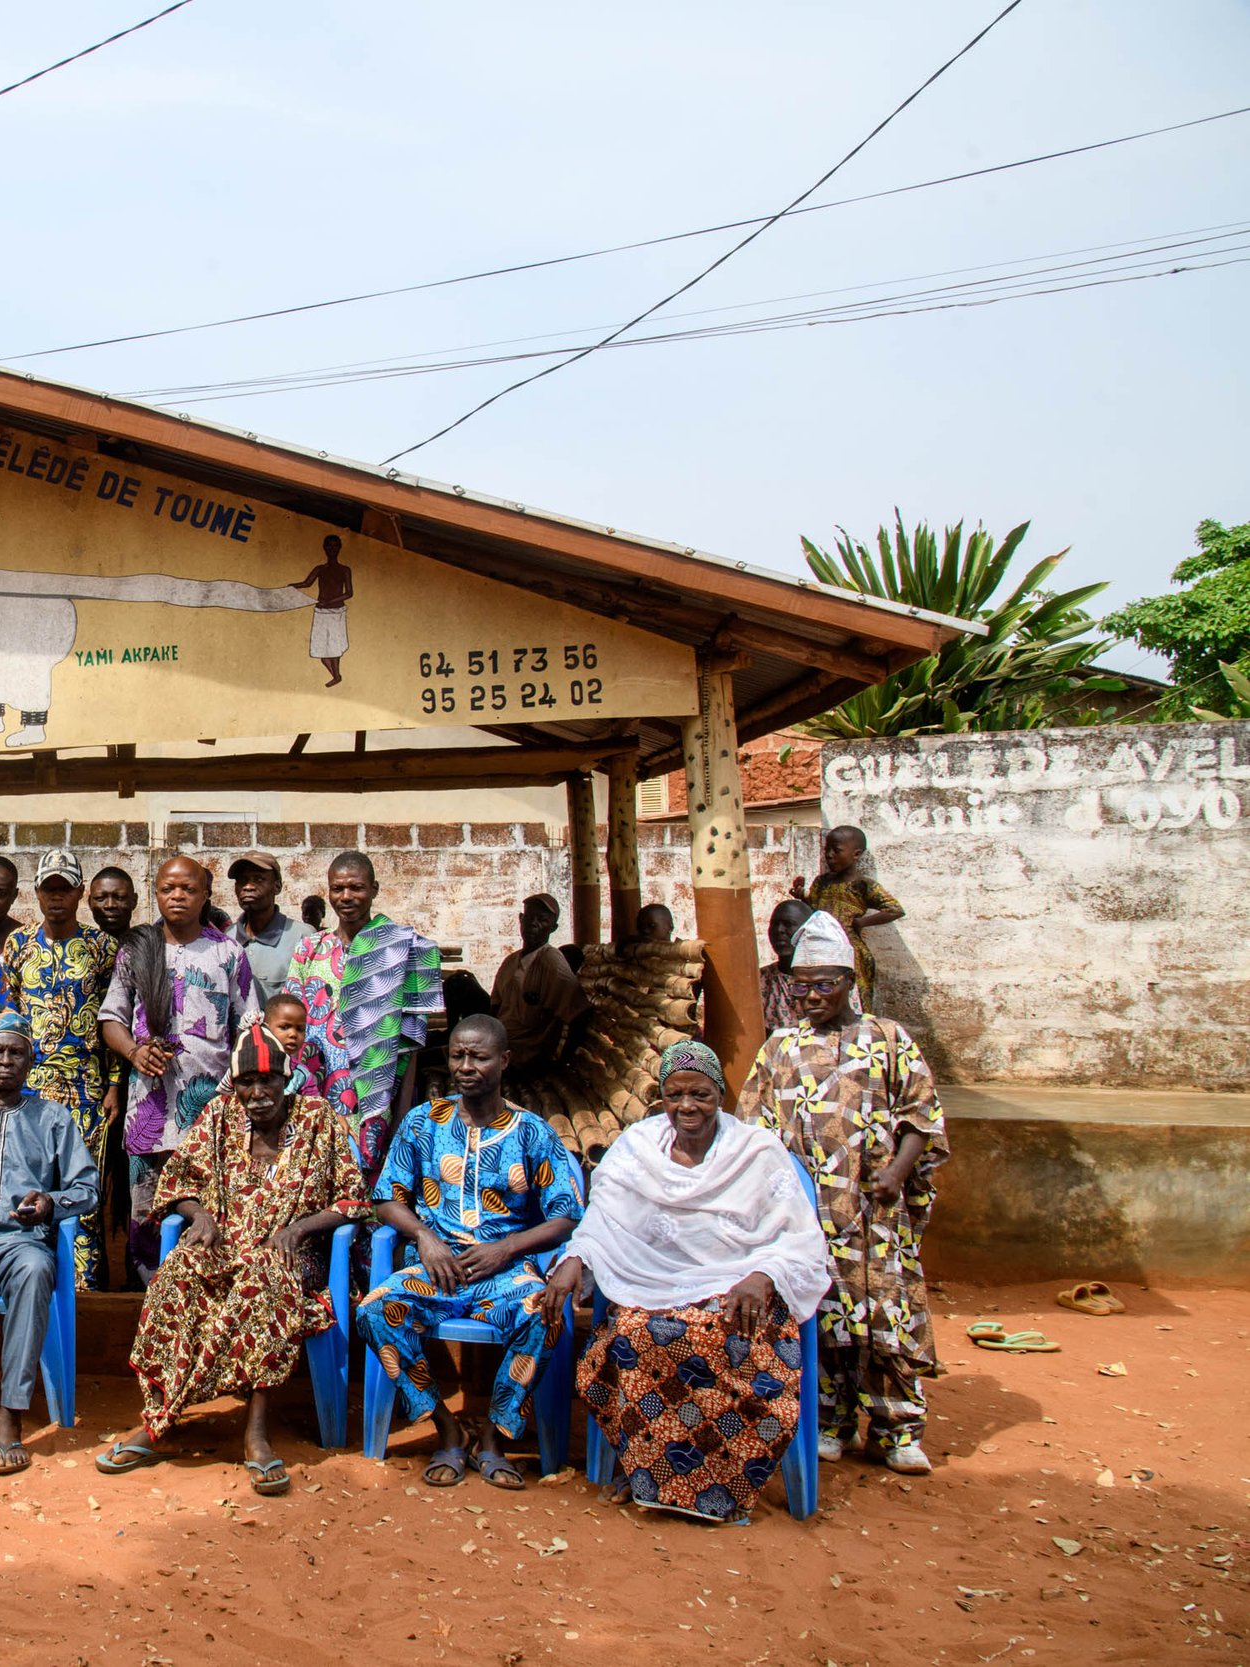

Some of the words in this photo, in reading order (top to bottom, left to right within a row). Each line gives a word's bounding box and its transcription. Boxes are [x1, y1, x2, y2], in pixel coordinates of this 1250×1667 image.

[96, 470, 141, 508] DE
[153, 486, 256, 543] TOUMÈ
[75, 649, 112, 666] YAMI
[121, 645, 178, 663] AKPAKE
[419, 652, 455, 678] 64
[468, 650, 498, 676] 51
[513, 647, 548, 673] 73
[564, 644, 598, 670] 56
[421, 687, 456, 714] 95
[470, 685, 507, 711] 25
[521, 682, 556, 708] 24
[570, 678, 602, 706] 02
[1100, 737, 1250, 782] AYEL
